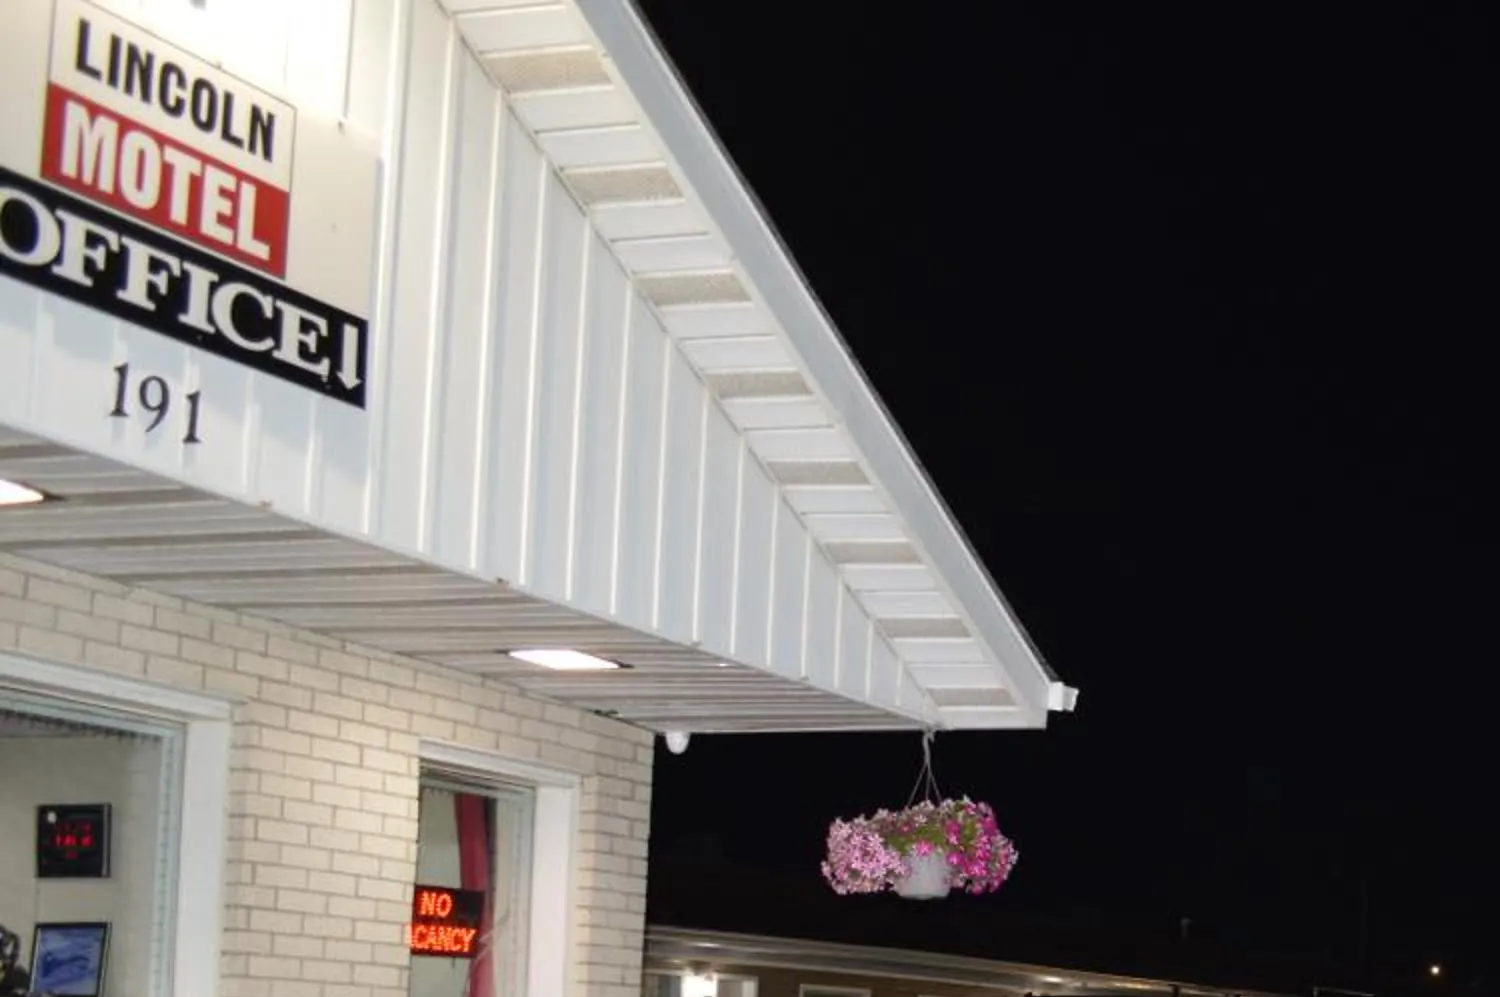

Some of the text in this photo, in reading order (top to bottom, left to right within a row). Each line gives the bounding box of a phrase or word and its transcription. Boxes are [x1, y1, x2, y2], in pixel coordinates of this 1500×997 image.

[75, 18, 275, 163] LINCOLN
[60, 99, 271, 261] MOTEL
[0, 186, 330, 382] OFFICE
[108, 362, 203, 445] 191
[410, 924, 477, 952] CANCY
[420, 890, 453, 918] NO
